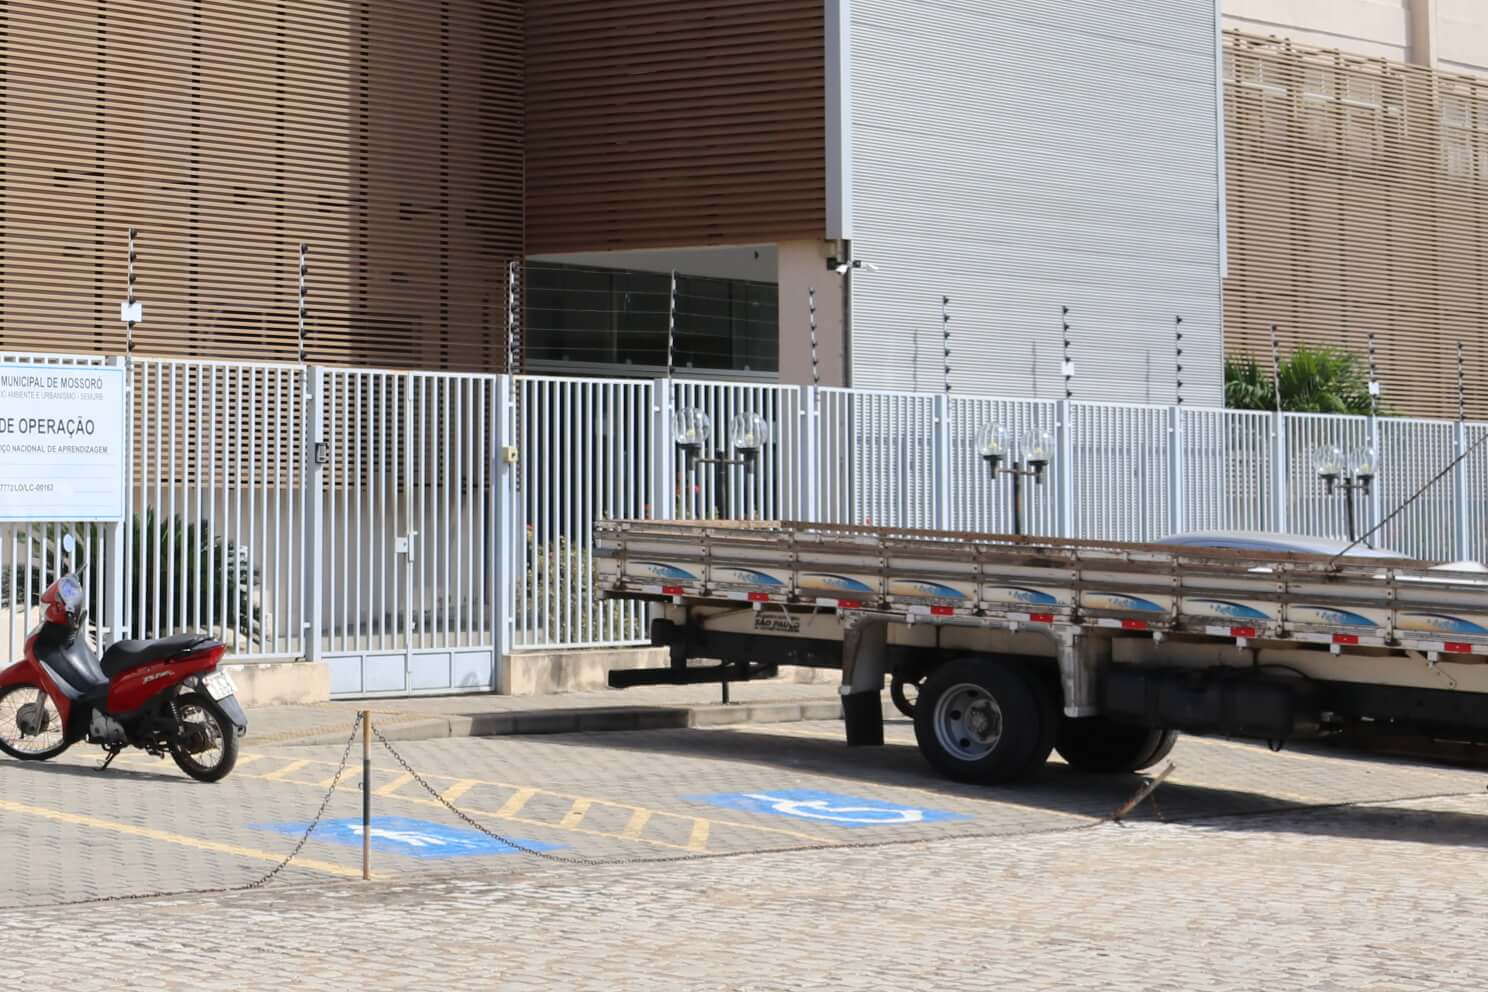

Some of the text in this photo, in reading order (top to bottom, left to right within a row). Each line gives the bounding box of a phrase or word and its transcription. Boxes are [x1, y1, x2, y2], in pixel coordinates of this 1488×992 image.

[1, 375, 45, 388] MUNICIPAL
[47, 377, 58, 388] DE
[60, 376, 103, 390] MOSSORÓ
[18, 416, 95, 439] OPERAÇÃO
[12, 445, 45, 453] NACIONAL
[47, 445, 57, 453] DE
[58, 445, 108, 454] APRENDIZAGEM
